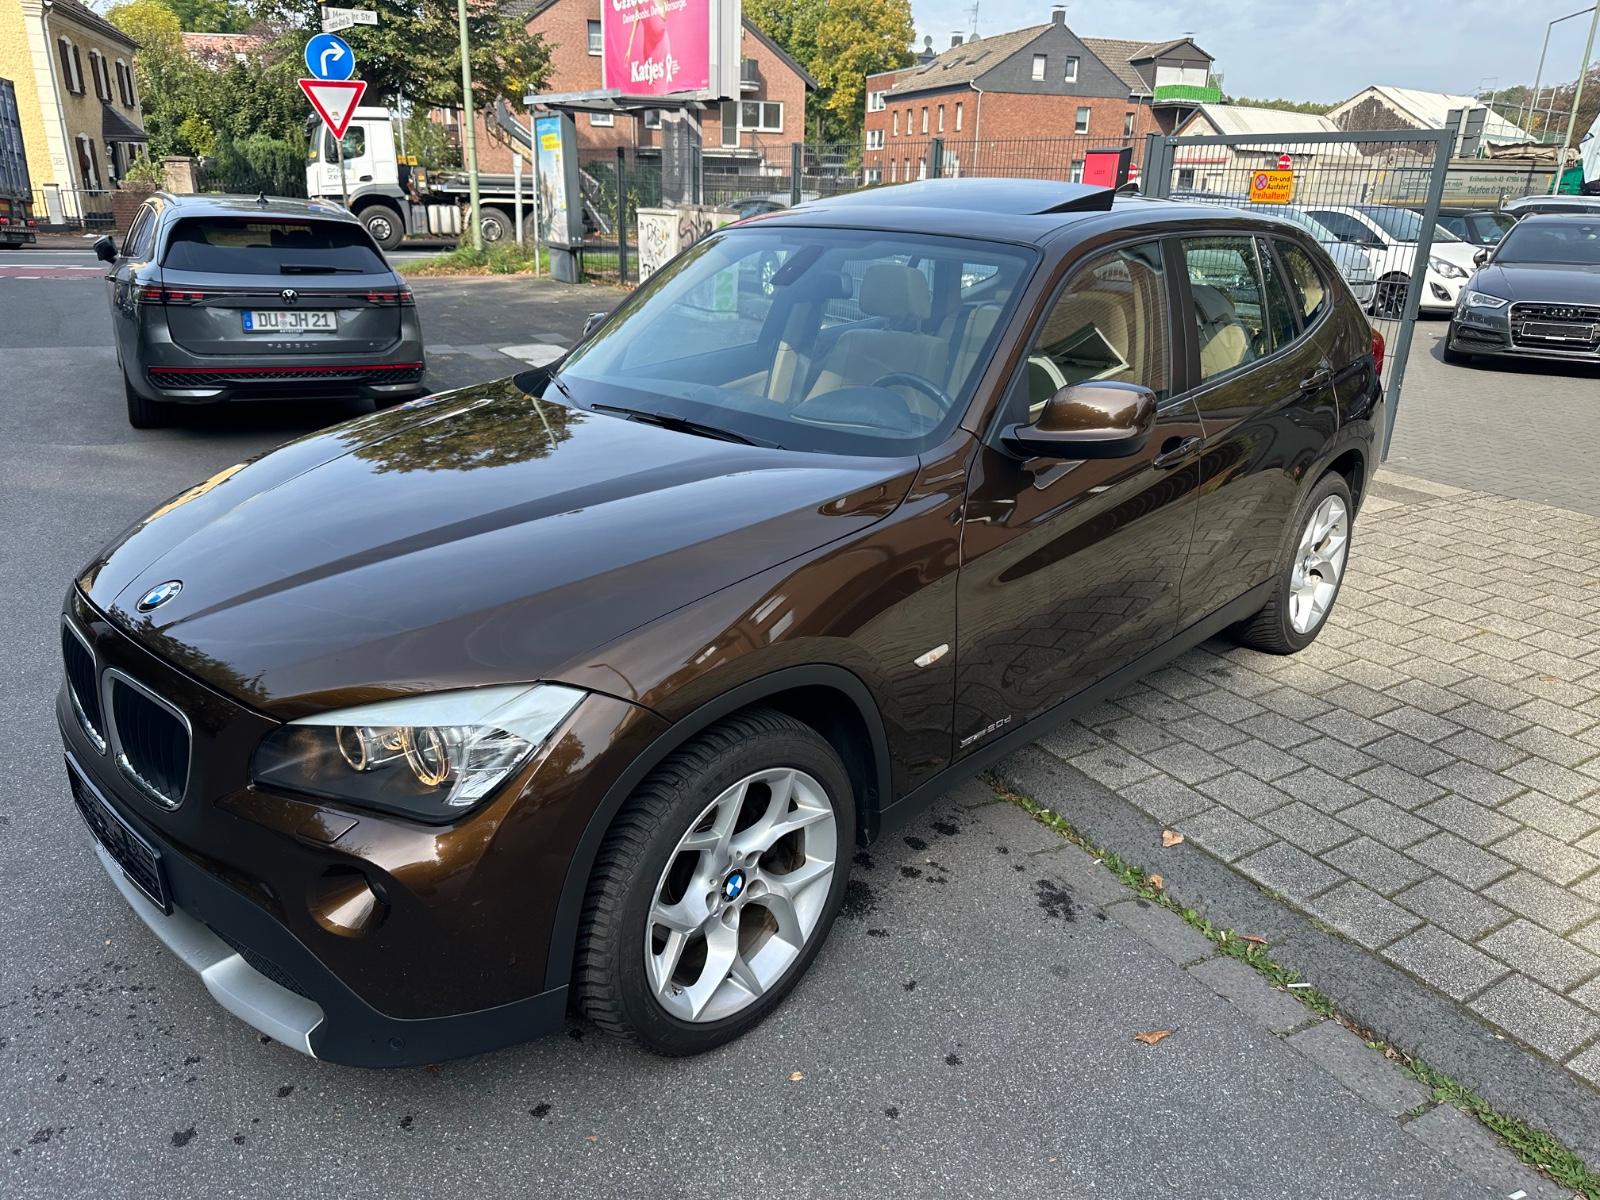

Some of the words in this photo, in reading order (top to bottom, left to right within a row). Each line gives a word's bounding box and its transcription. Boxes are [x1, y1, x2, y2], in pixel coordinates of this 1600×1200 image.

[630, 57, 664, 85] Katjes
[1253, 192, 1288, 200] freihalten!
[257, 313, 279, 328] DU
[289, 313, 309, 328] JH
[312, 313, 331, 328] 21
